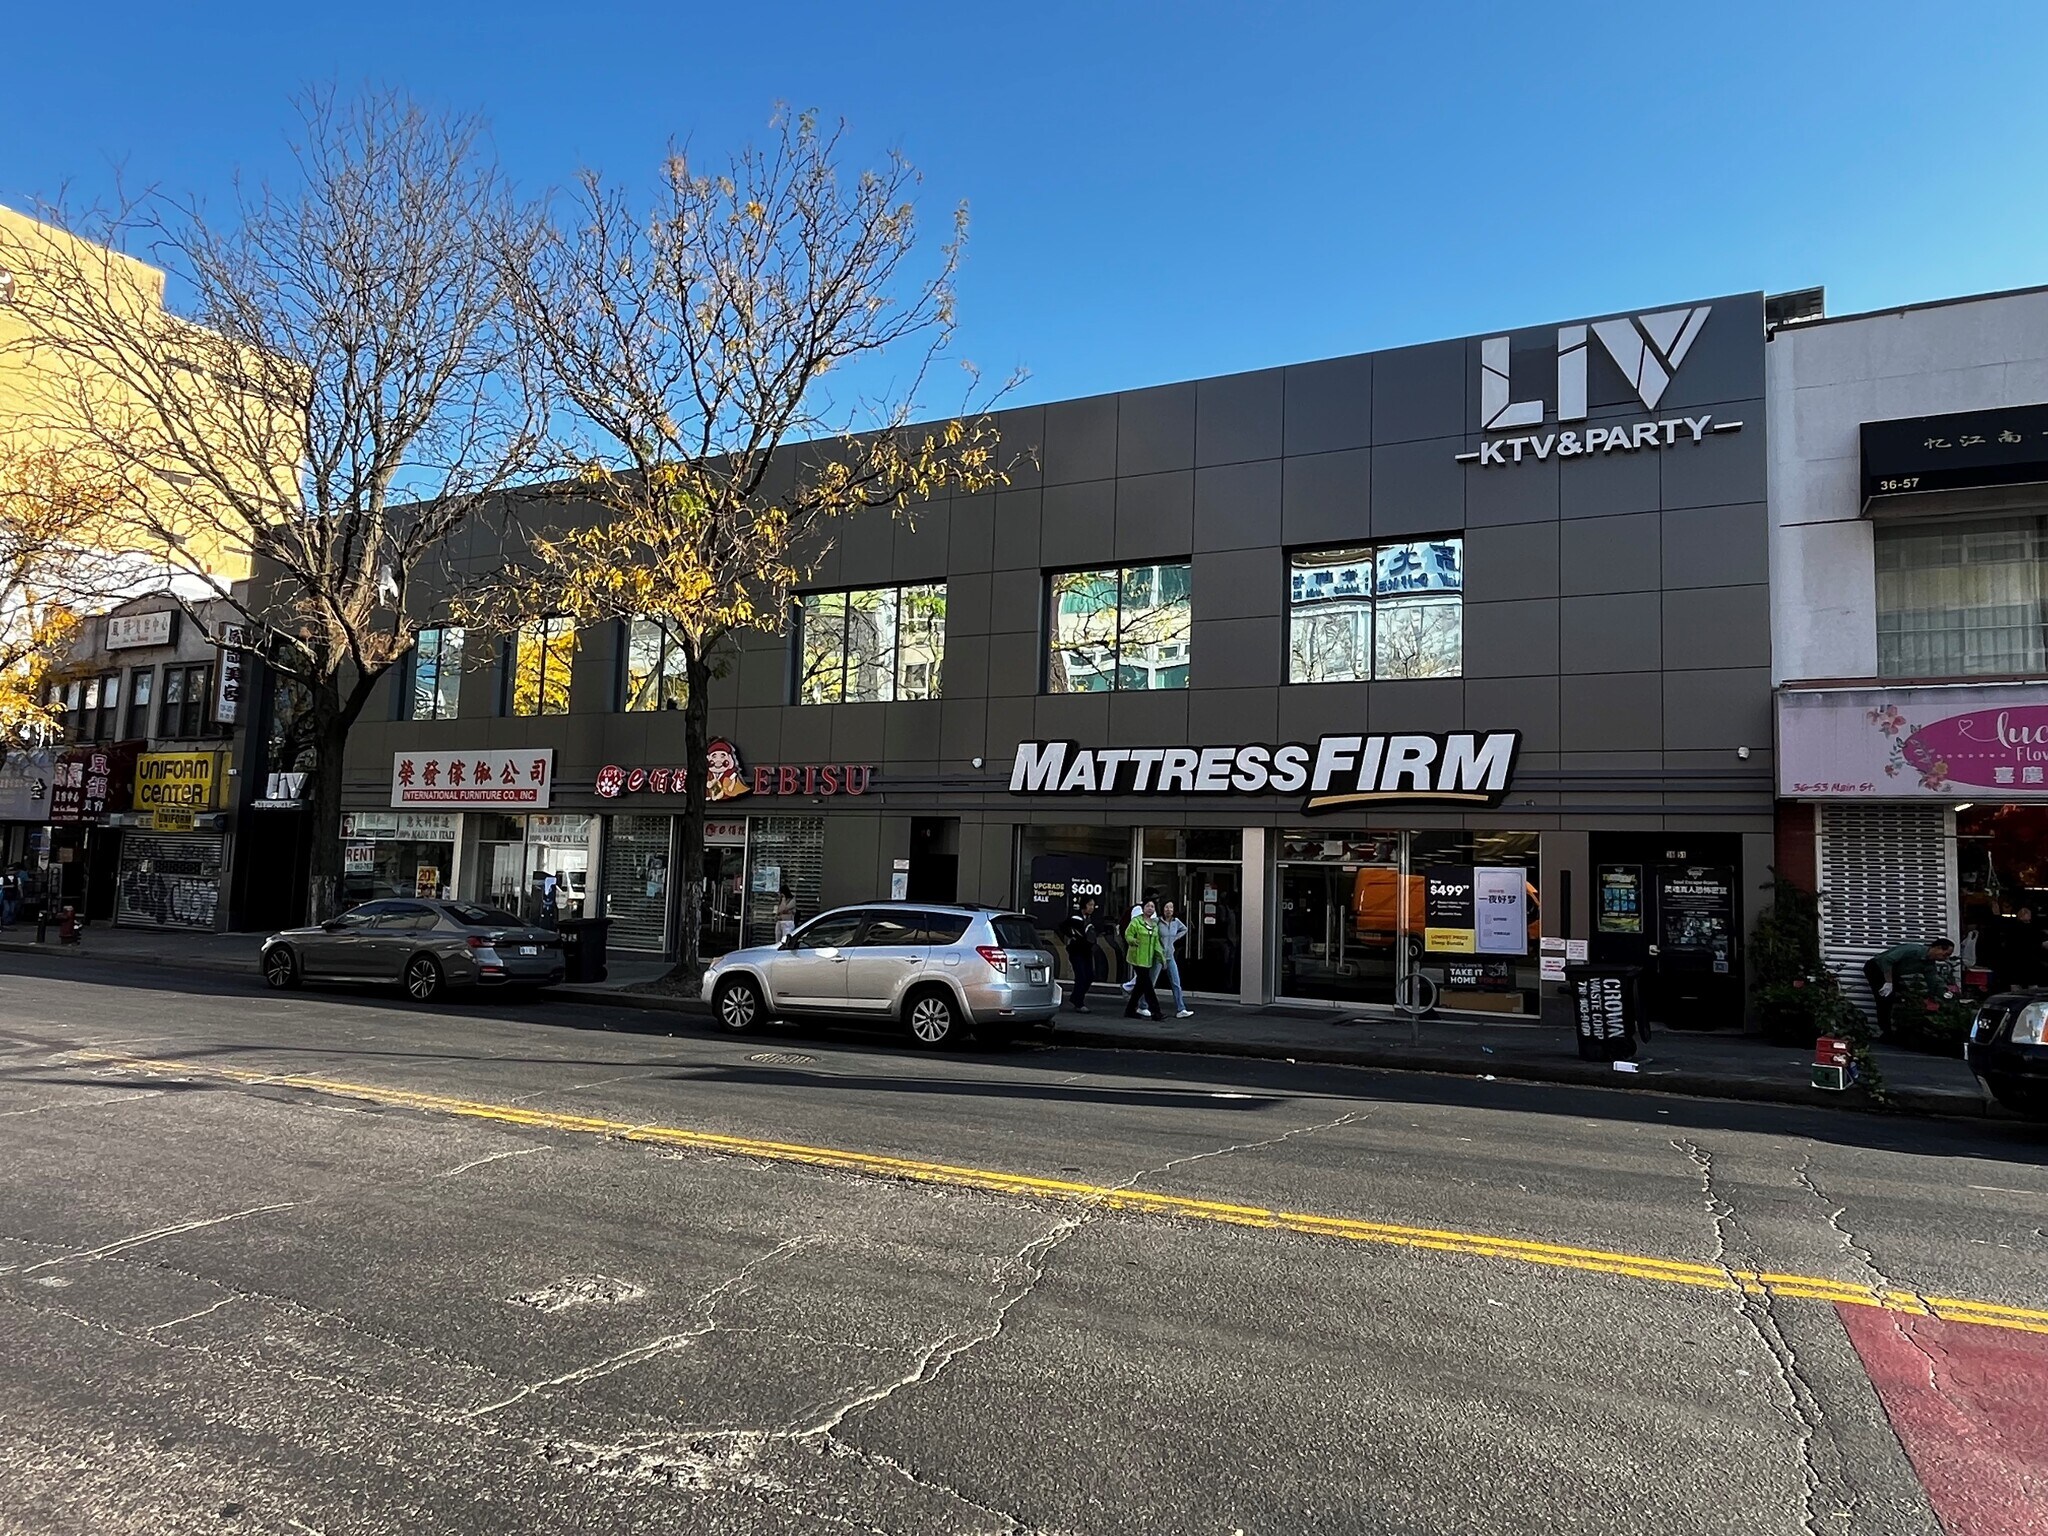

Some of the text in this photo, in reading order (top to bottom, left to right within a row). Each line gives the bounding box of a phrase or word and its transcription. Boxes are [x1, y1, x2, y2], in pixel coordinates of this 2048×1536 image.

[1481, 305, 1712, 430] LIV
[1480, 414, 1712, 466] KTV&PARTY
[1923, 429, 2048, 450] 忆江南
[1880, 477, 1920, 490] 36-57
[139, 759, 209, 779] UNIFORM
[1009, 733, 1516, 792] MATTRESS FIRM
[753, 765, 872, 796] EBISU
[1792, 782, 1876, 792] 36-53 Main St.
[403, 789, 459, 800] INTERNATIONAL
[459, 789, 502, 800] FURNITURE
[519, 789, 536, 800] INC.
[346, 848, 374, 862] RENT
[1033, 882, 1065, 890] UPGRADE
[1071, 883, 1103, 896] $600
[1033, 895, 1049, 903] SALE
[1449, 968, 1483, 976] TAKE IT
[1450, 976, 1477, 984] HOME
[1589, 977, 1605, 1040] WASTE CORP
[1602, 978, 1626, 1038] CROWN
